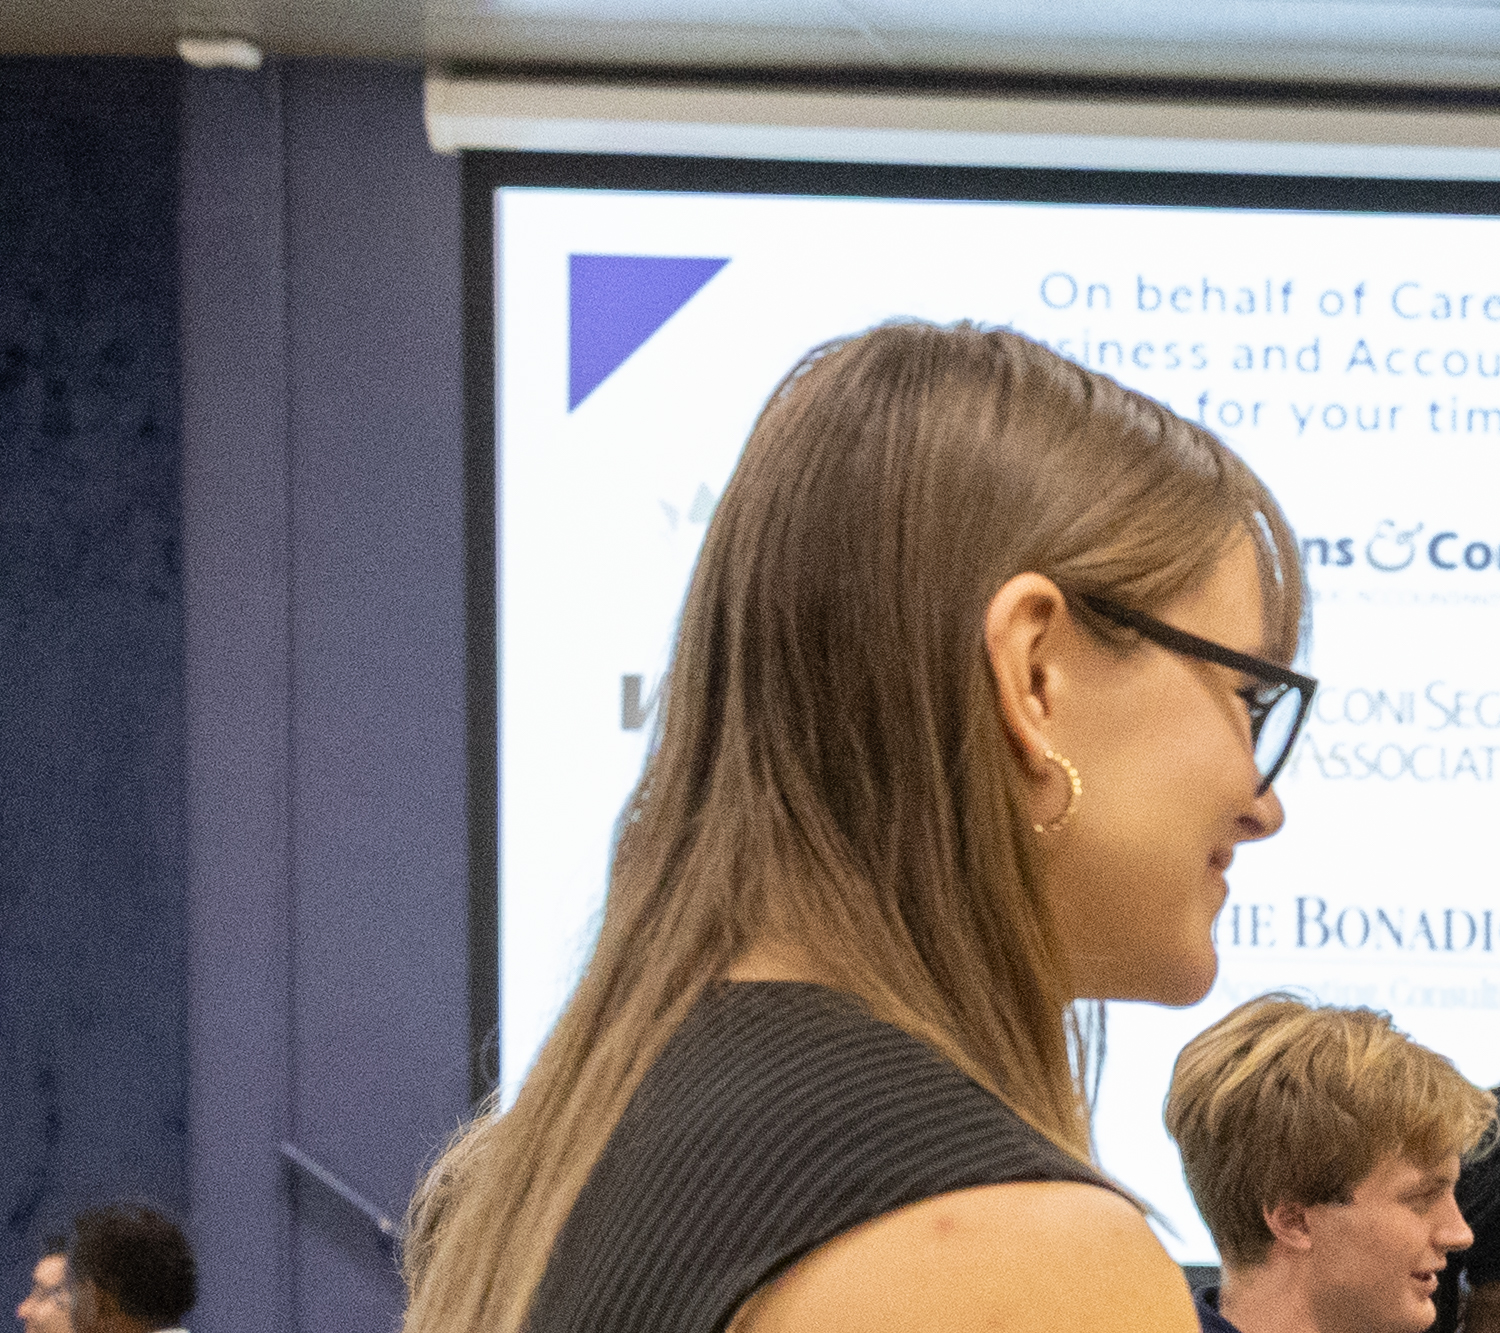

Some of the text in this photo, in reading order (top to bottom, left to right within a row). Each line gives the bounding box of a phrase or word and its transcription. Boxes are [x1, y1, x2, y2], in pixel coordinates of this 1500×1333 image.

[1040, 271, 1112, 311] On
[1137, 274, 1292, 316] behalf
[1319, 282, 1368, 317] of
[1232, 336, 1319, 374] and
[1290, 401, 1403, 438] your
